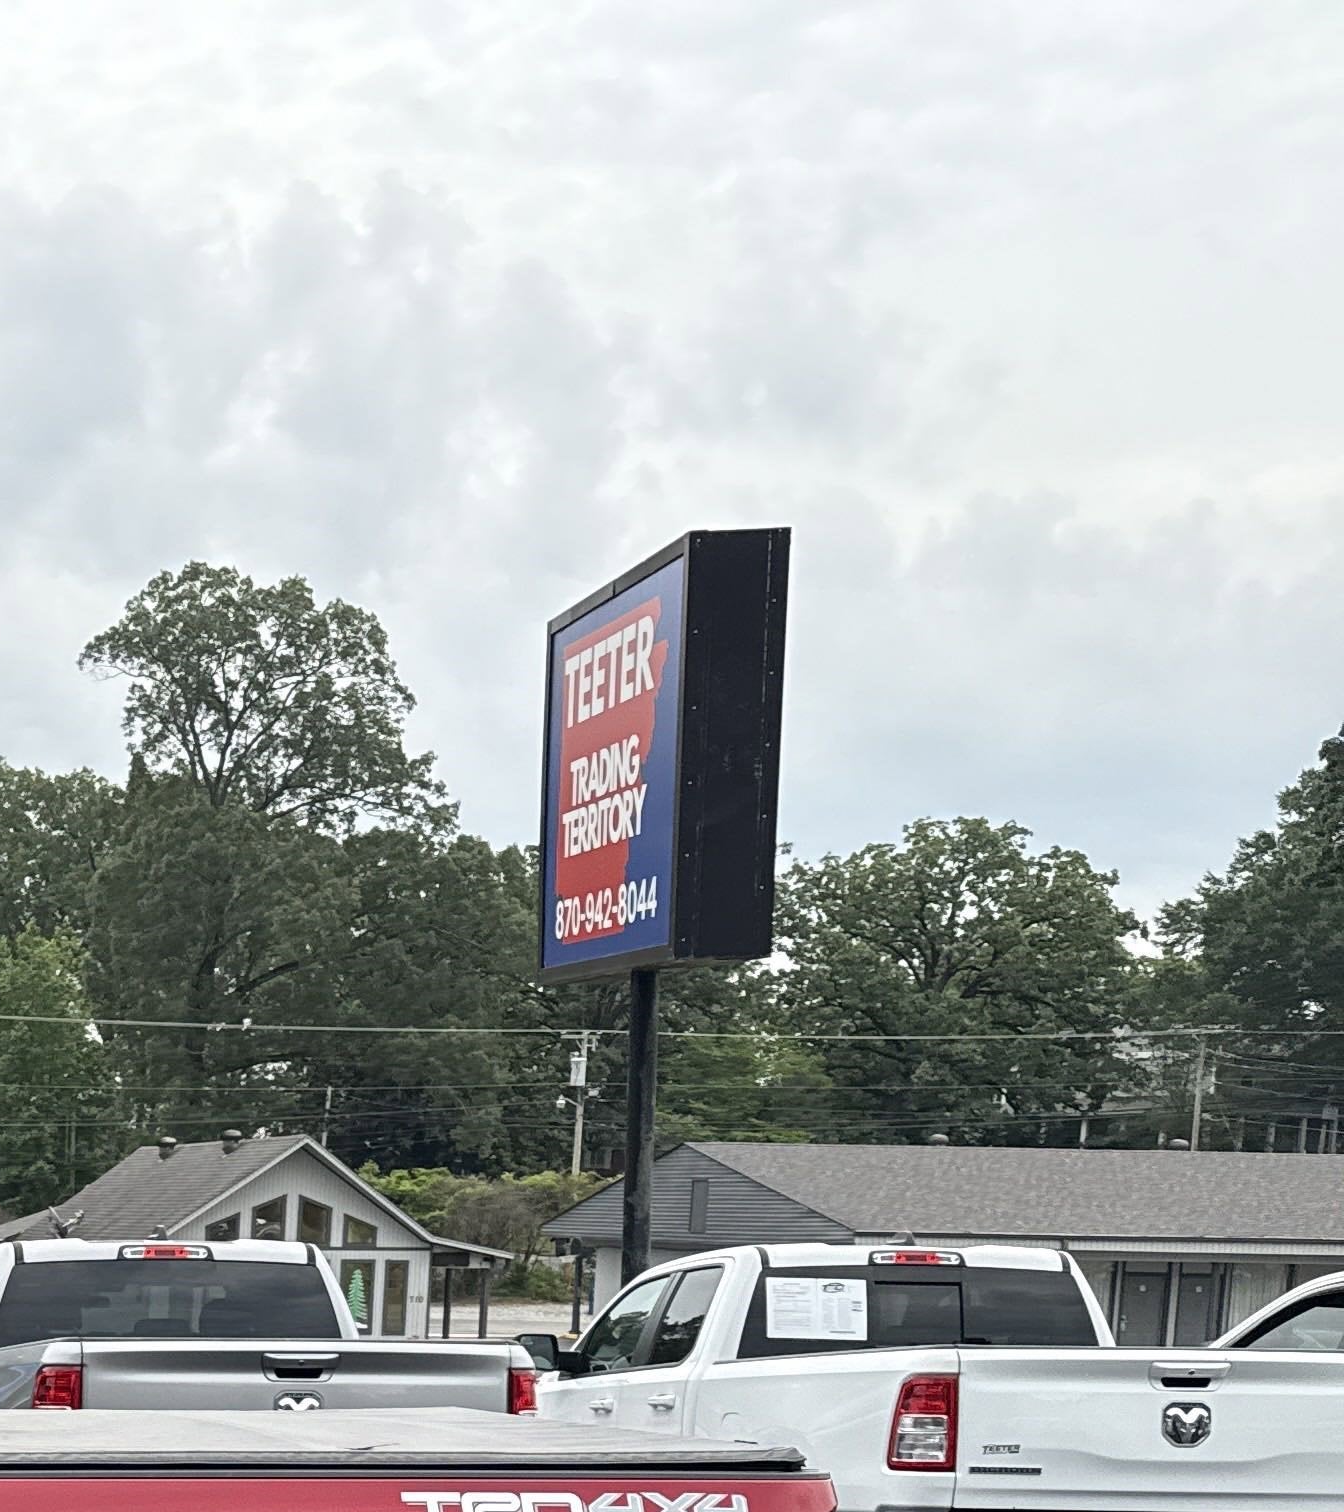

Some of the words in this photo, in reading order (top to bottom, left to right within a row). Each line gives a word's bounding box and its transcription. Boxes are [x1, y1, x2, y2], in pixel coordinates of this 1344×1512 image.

[564, 615, 655, 729] TEETER
[570, 734, 641, 807] TRADING
[562, 784, 648, 858] TERRITORY
[555, 876, 658, 940] 870-942-8044
